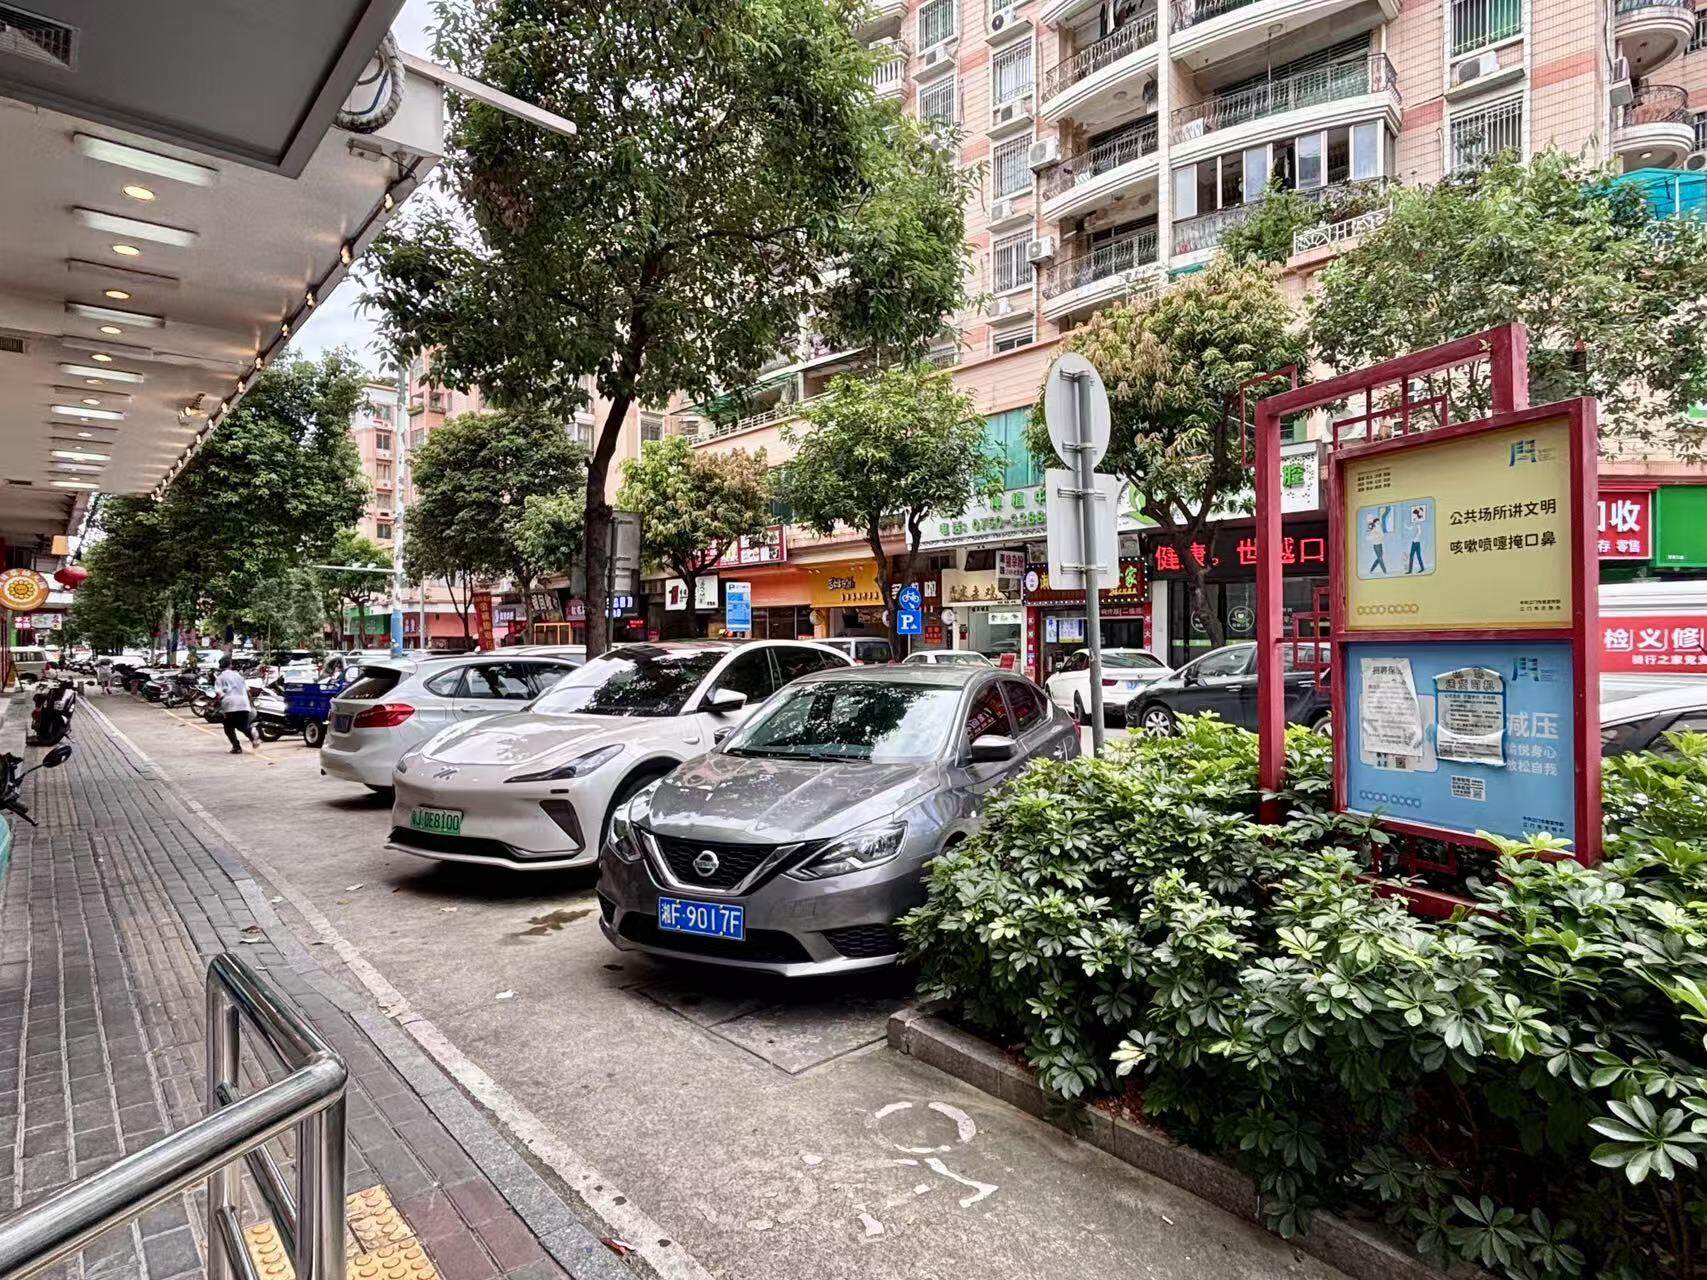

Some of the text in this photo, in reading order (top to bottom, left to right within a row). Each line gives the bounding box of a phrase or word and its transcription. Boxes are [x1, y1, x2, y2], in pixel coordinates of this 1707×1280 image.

[1449, 498, 1557, 526] 公共场所讲文明
[1449, 531, 1557, 555] 咳嗽喷嚏掩口鼻
[1616, 539, 1641, 553] 零售
[900, 614, 914, 630] P
